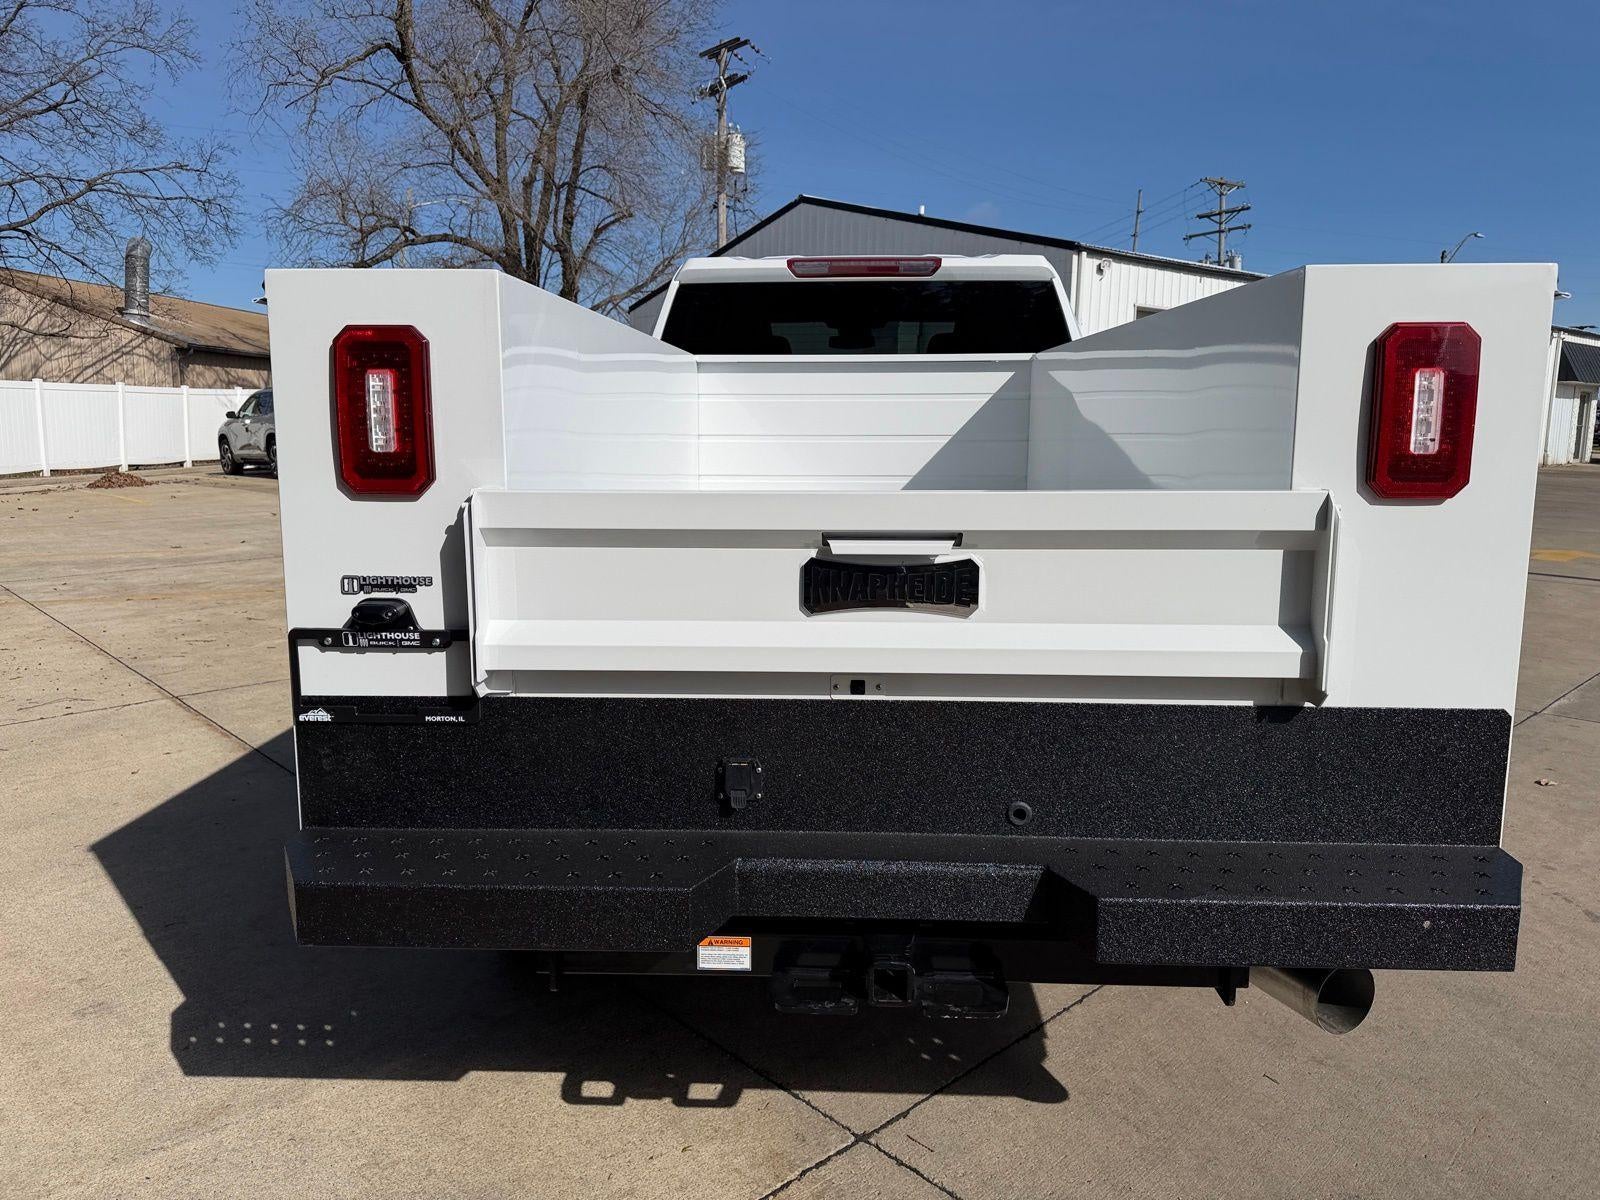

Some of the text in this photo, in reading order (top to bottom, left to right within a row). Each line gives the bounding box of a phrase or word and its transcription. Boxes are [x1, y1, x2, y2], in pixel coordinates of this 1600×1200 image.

[360, 576, 433, 586] LIGHTHOUSE
[811, 565, 972, 606] KNAPHEIDE
[358, 632, 420, 640] LIGHTHOUSE
[299, 713, 332, 722] everest
